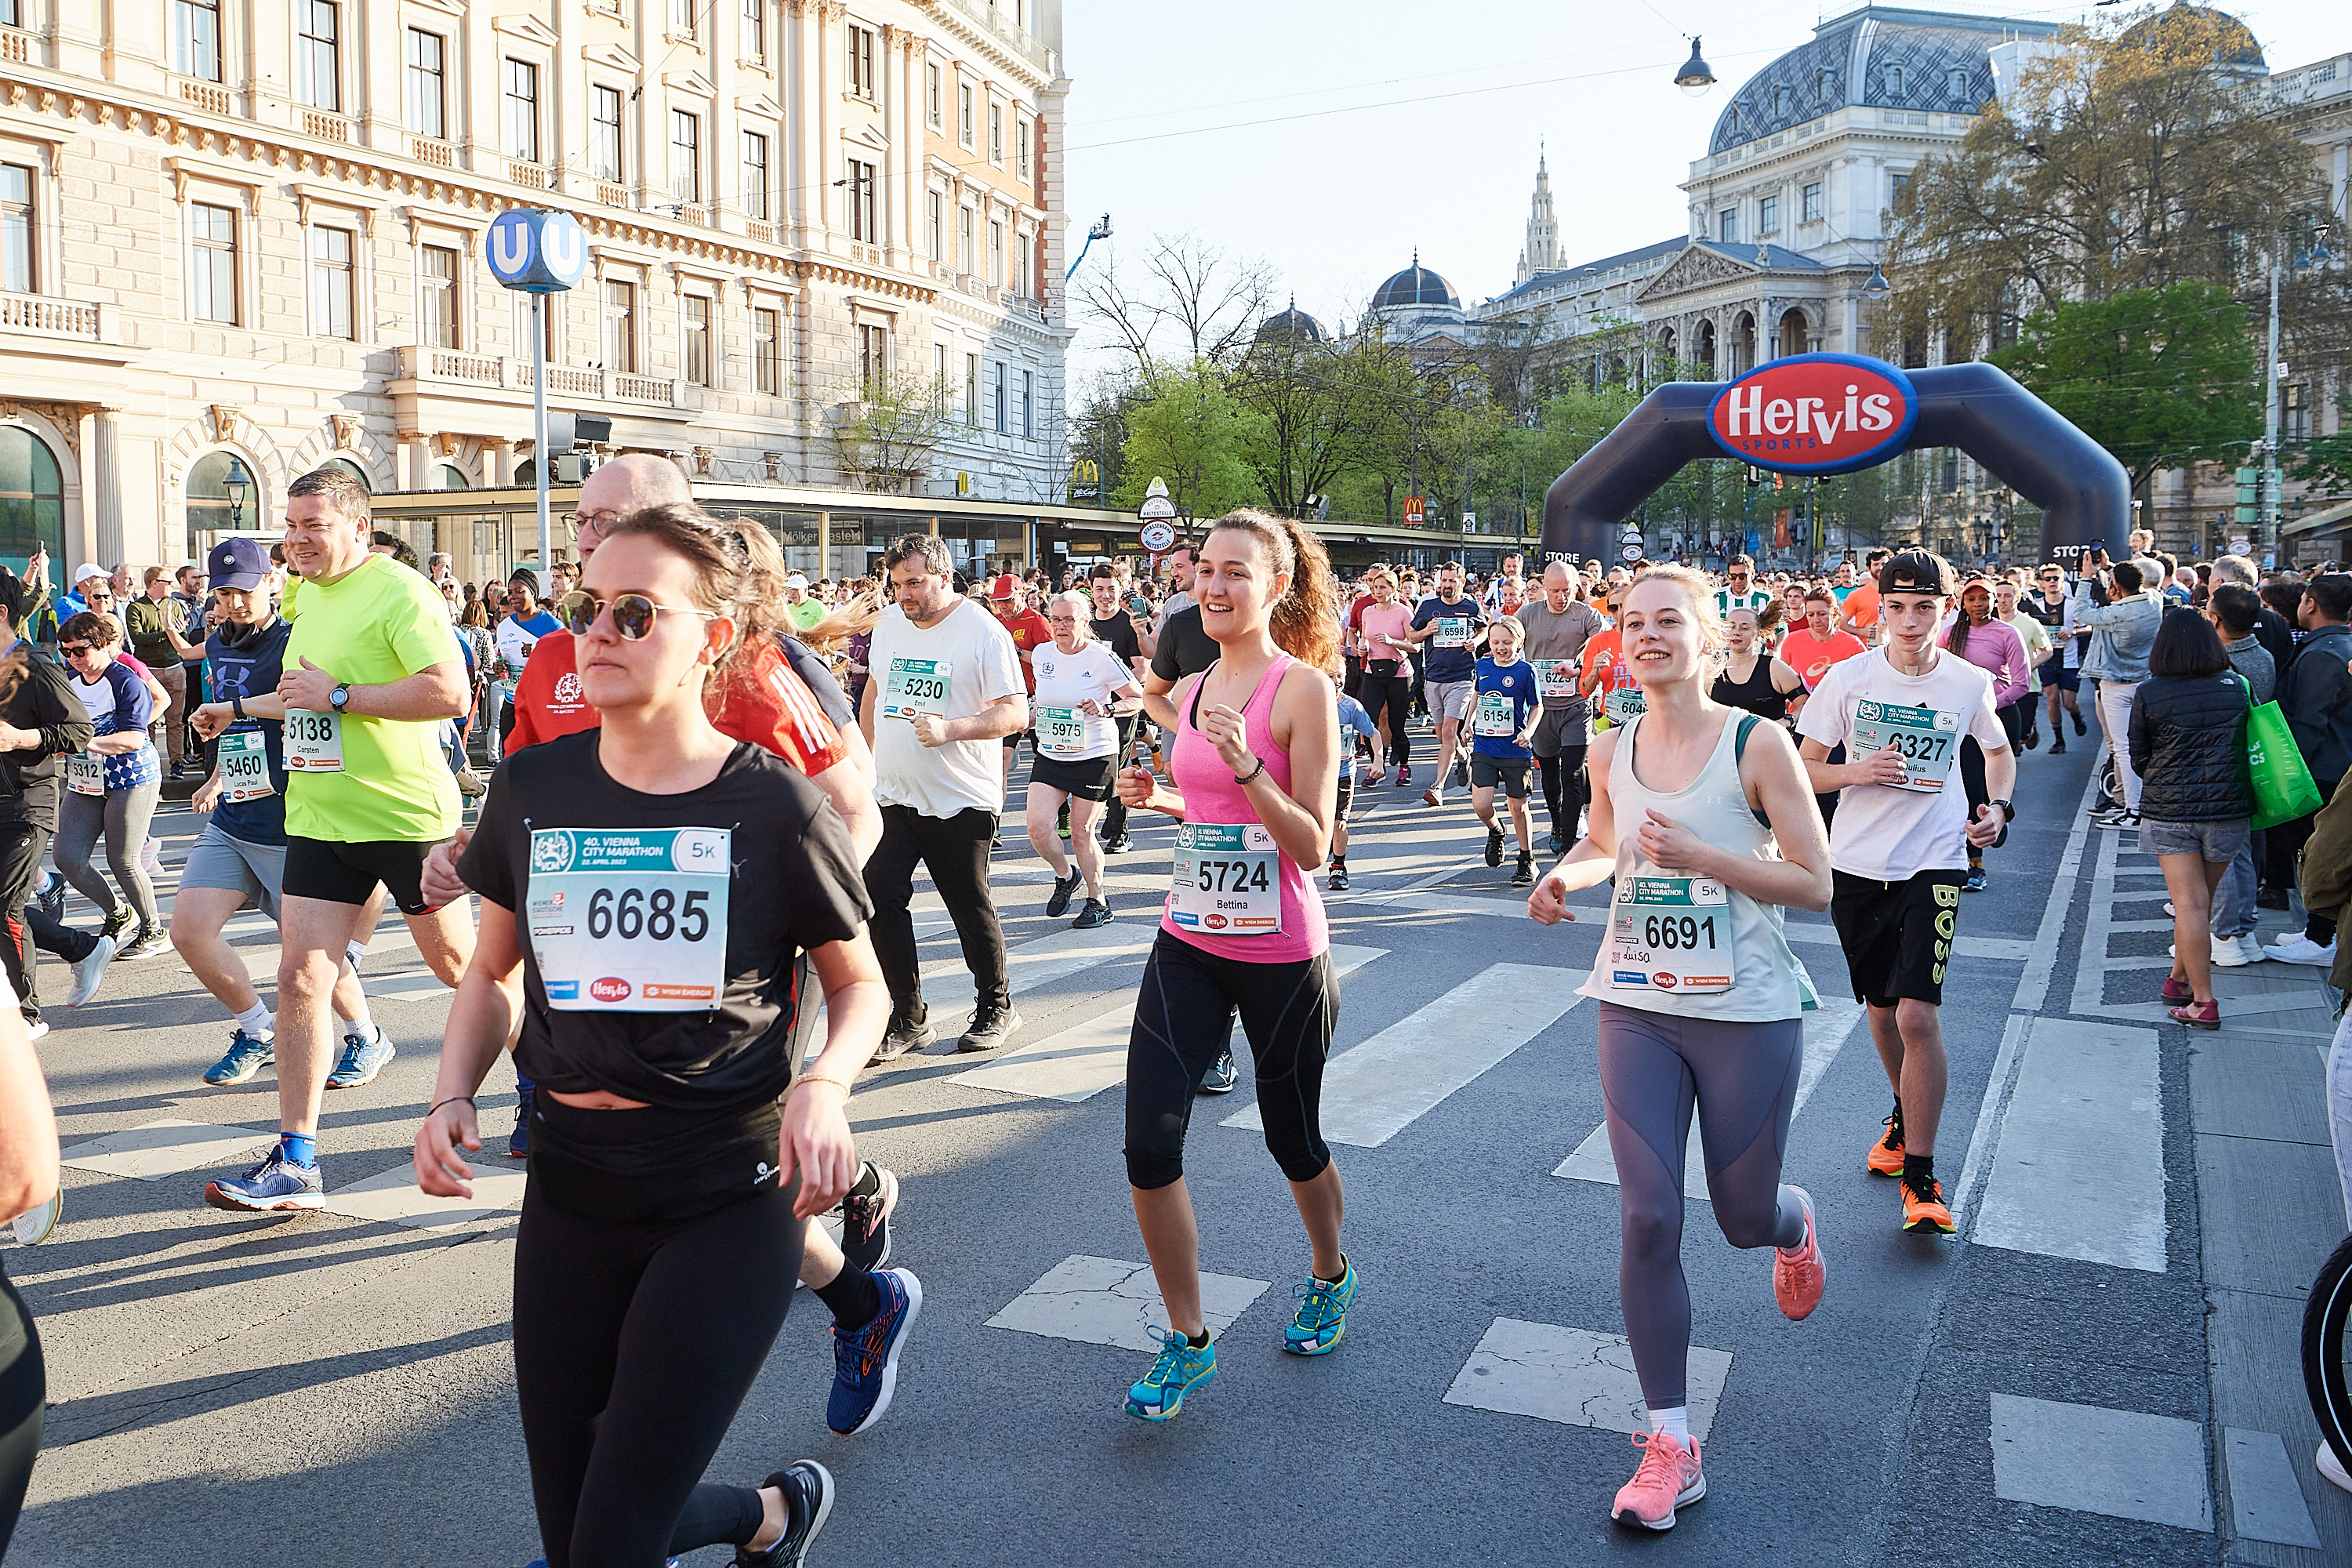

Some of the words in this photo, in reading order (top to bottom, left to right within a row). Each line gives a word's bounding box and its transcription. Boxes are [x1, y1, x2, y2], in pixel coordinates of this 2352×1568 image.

[493, 223, 528, 274] U
[548, 223, 581, 275] U
[1729, 384, 1893, 445] Hervis
[1742, 437, 1816, 451] SPORTS
[1143, 523, 1171, 535] STRASSENBAHN
[784, 530, 818, 542] Mölker
[829, 530, 854, 541] astei
[1145, 539, 1171, 549] HALTESTELLE
[1545, 551, 1580, 564] STORE
[2053, 545, 2091, 558] STO
[1444, 627, 1465, 636] 6598
[905, 678, 943, 699] 5230
[1621, 702, 1646, 714] 604
[1484, 710, 1510, 721] 6154
[289, 716, 332, 742] 5138
[1052, 723, 1081, 737] 5975
[1889, 732, 1947, 761] 6327
[73, 763, 99, 778] 5312
[227, 755, 261, 778] 5460
[584, 837, 600, 847] 40.
[603, 837, 640, 847] VIENNA
[1254, 833, 1269, 842] 5K
[583, 847, 605, 856] CITY
[606, 847, 663, 856] MARATHON
[691, 842, 715, 858] 5K
[541, 861, 560, 871] VCM
[1199, 861, 1269, 892] 5724
[1702, 886, 1718, 896] 5K
[1217, 899, 1248, 909] Bettina
[588, 888, 710, 942] 6685
[1206, 916, 1226, 926] Hervis
[1646, 916, 1716, 949] 6691
[1933, 884, 1959, 984] BOSS
[1655, 975, 1675, 985] Hervis
[593, 982, 629, 998] Hervis
